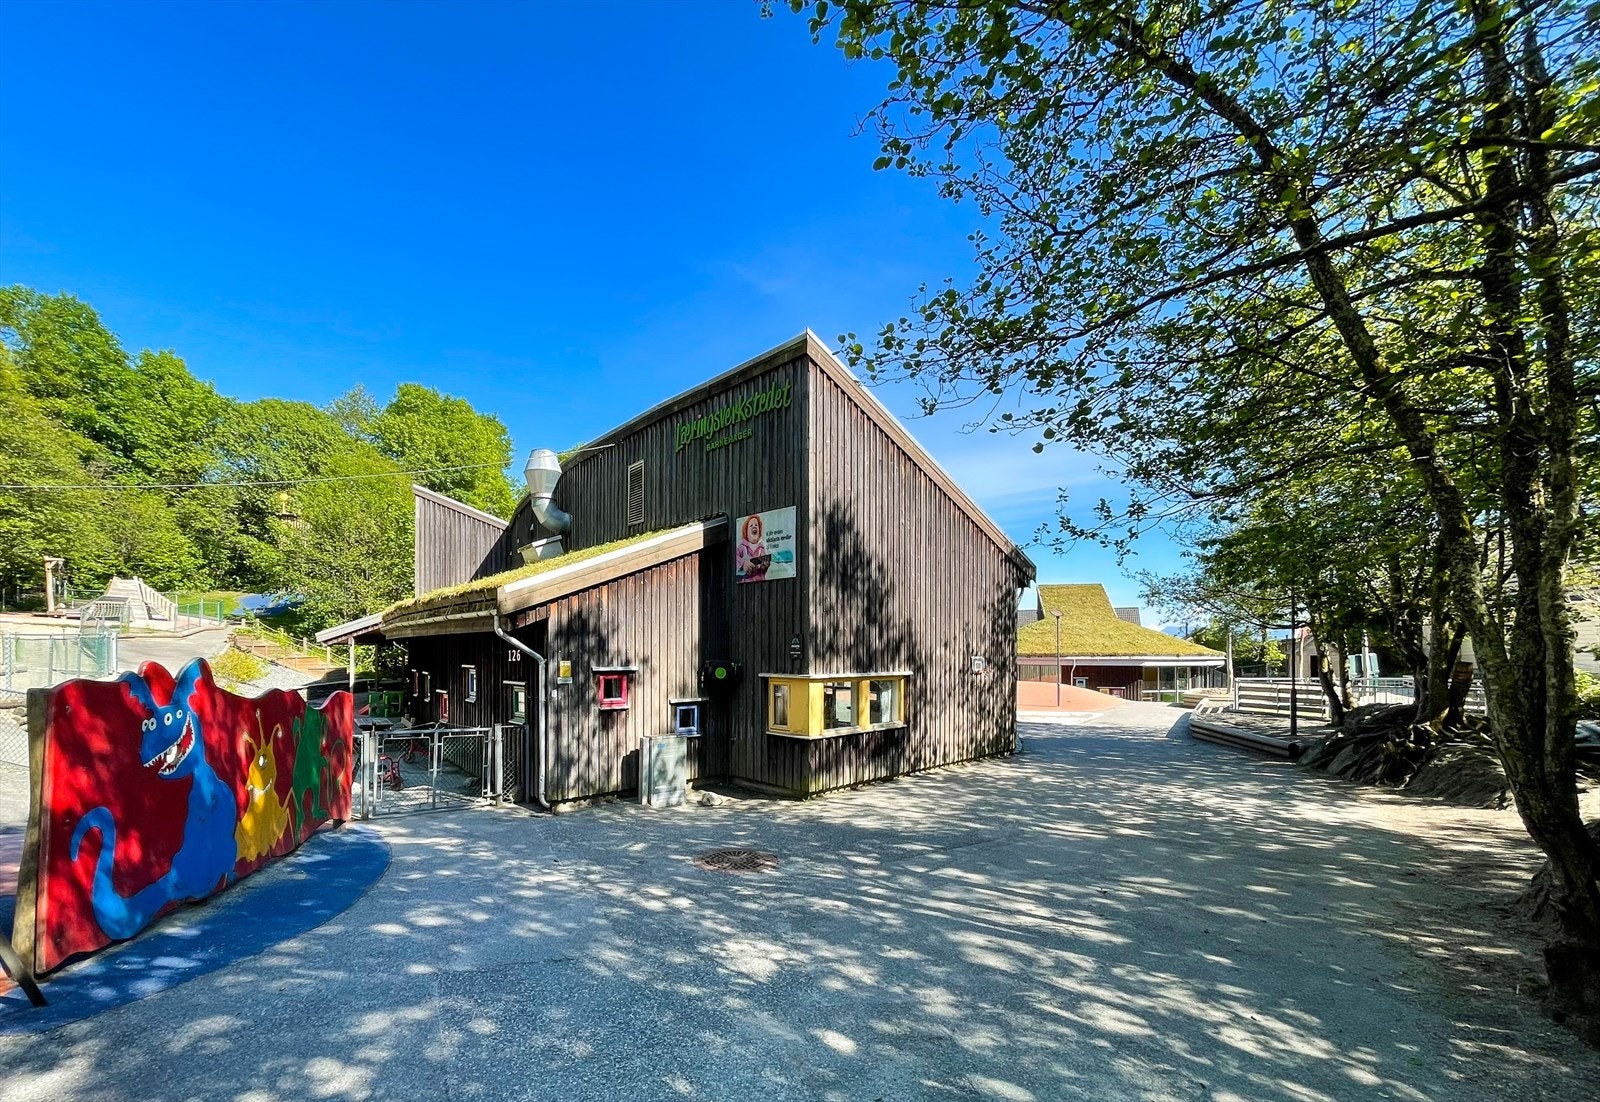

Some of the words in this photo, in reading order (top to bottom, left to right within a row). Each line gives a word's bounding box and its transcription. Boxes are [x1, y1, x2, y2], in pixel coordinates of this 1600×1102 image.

[674, 378, 792, 453] Læringsverkstedet
[706, 428, 753, 452] BARNEHAGER
[508, 649, 521, 662] 126
